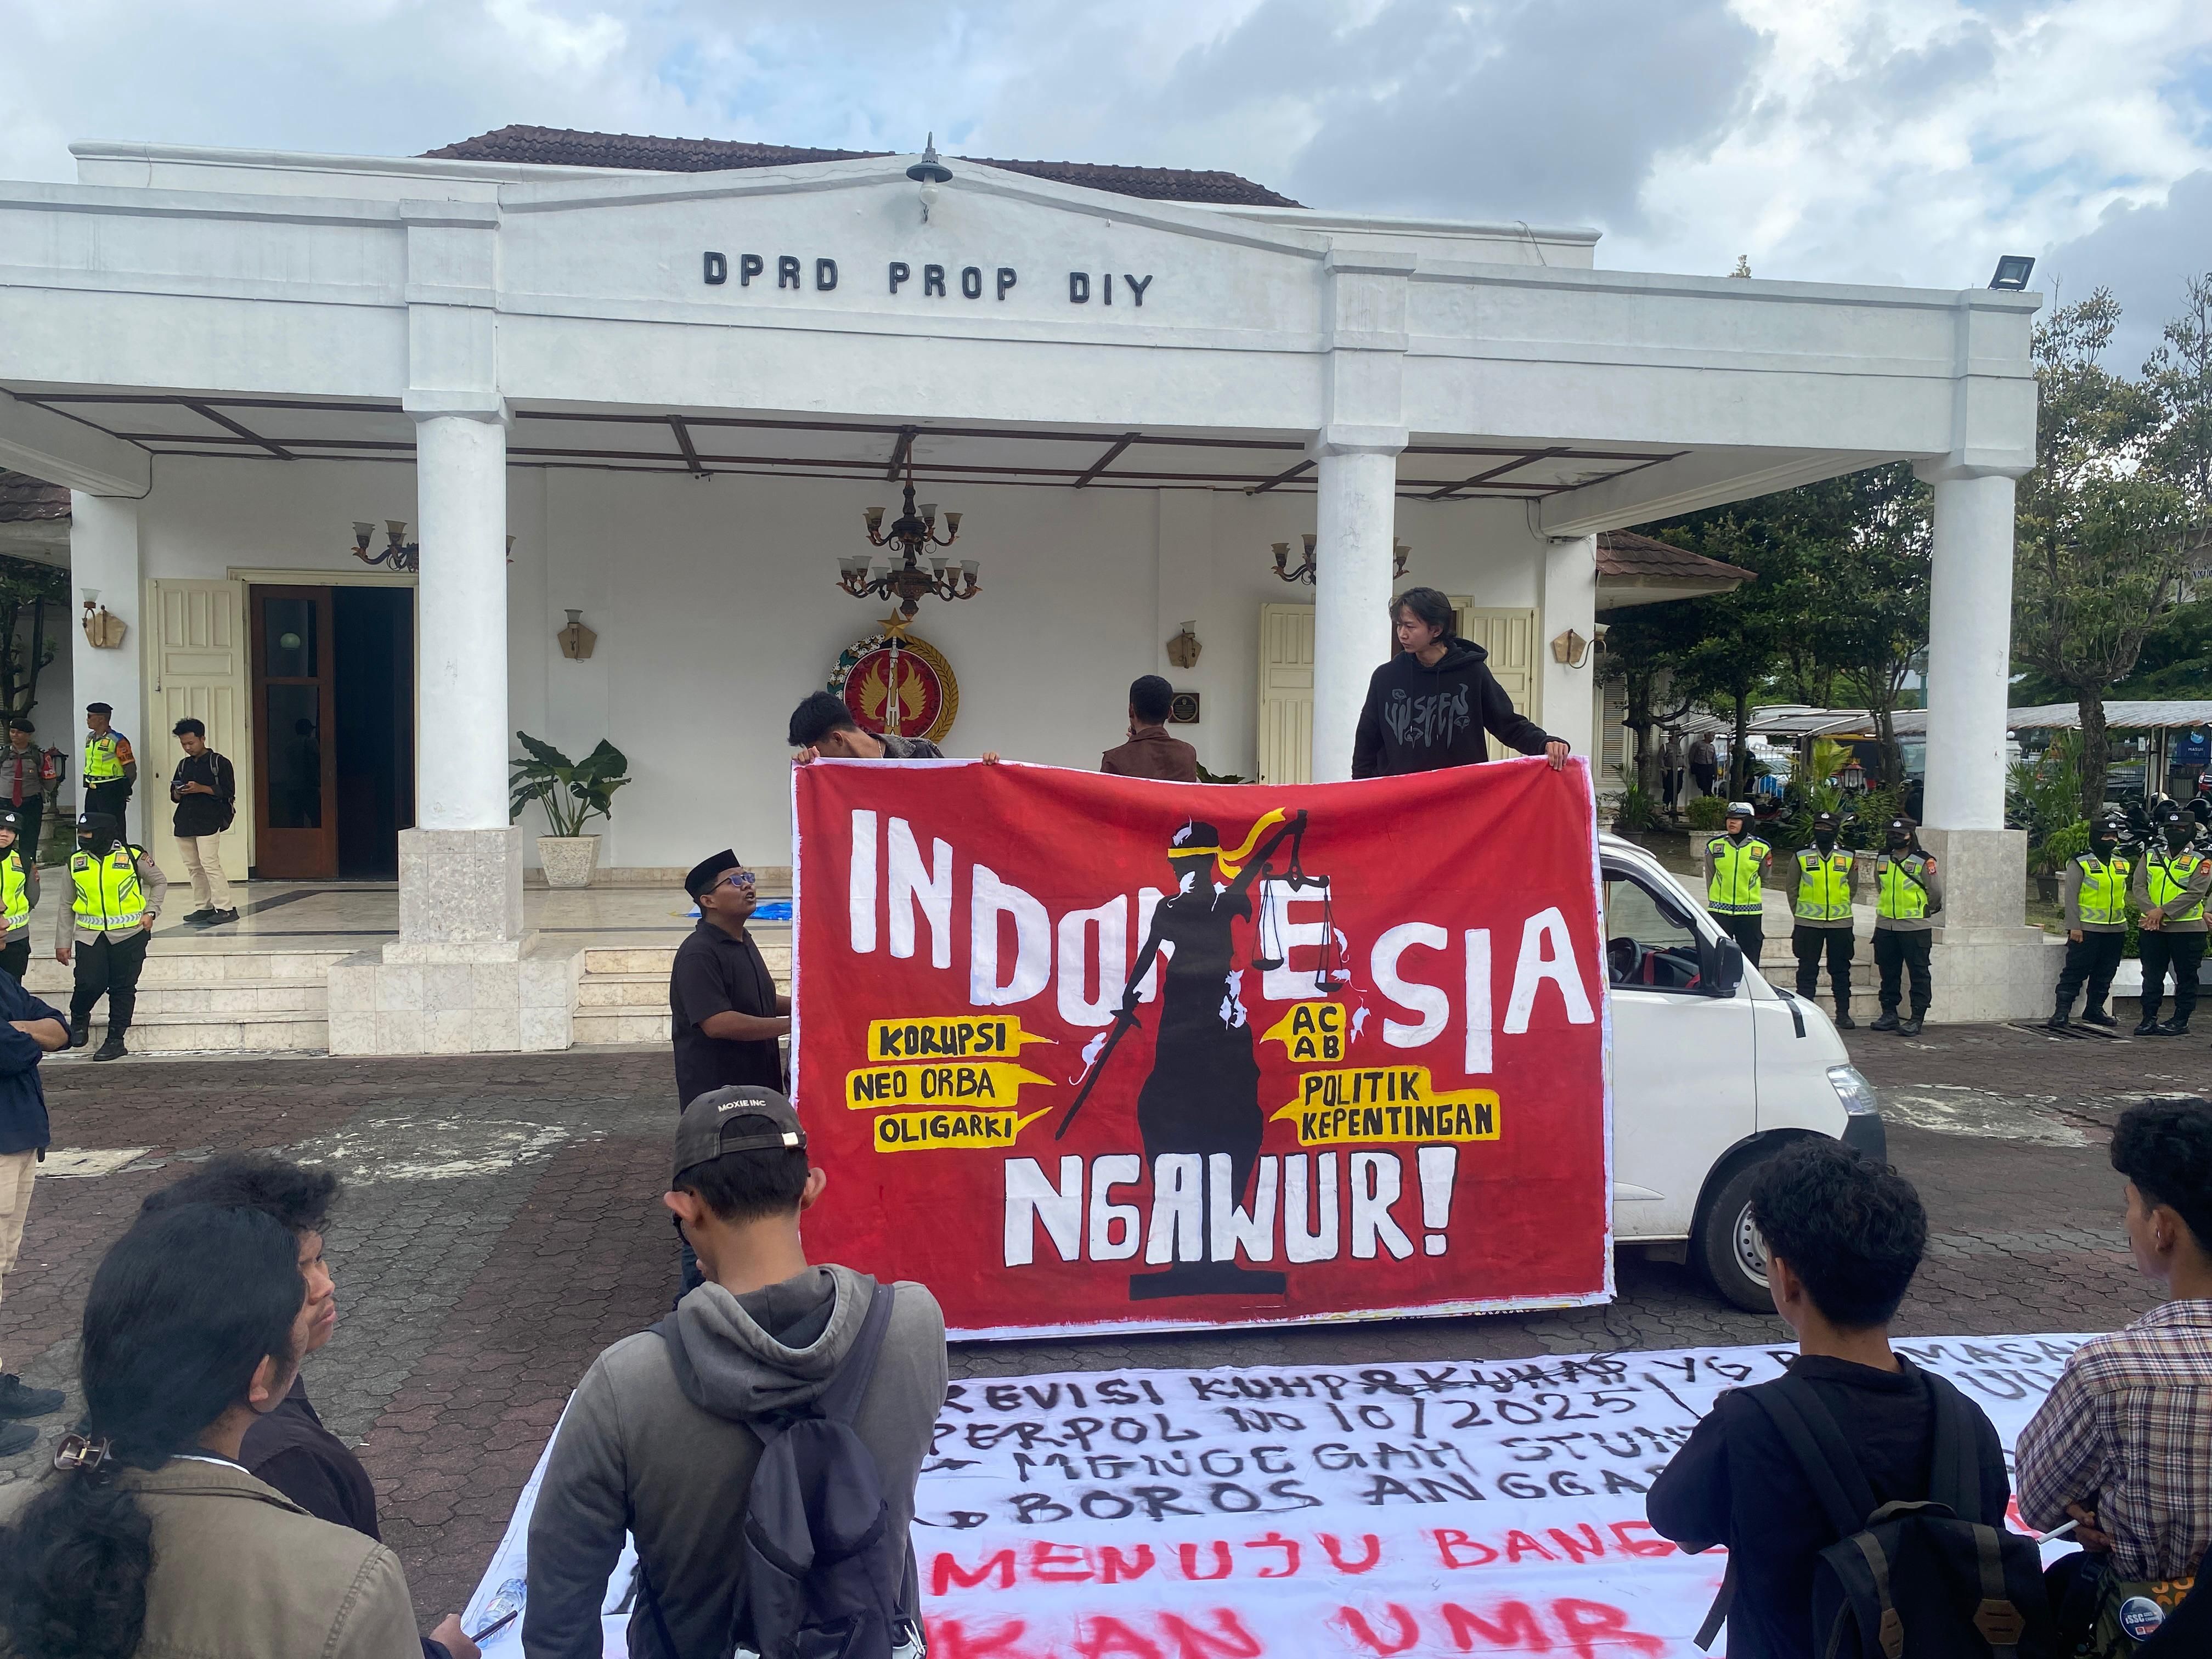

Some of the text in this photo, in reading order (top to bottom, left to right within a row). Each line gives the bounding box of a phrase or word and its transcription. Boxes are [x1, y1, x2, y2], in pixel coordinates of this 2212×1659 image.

[703, 251, 1154, 307] DPRD PROP DIY
[1292, 1005, 1338, 1036] AC
[879, 1022, 1006, 1057] KORUPSI
[1294, 1035, 1340, 1059] AB
[853, 1067, 995, 1102] NEO ORBA
[1305, 1071, 1420, 1107] POLITIK
[718, 1099, 767, 1113] MOXIE INC
[1302, 1103, 1494, 1141] KEPENTINGAN
[879, 1114, 1012, 1143] OLIGARKI
[1004, 1144, 1459, 1267] NGAWUR!
[938, 1378, 1164, 1414] REVISI
[929, 1413, 1203, 1455] PERPOL
[1220, 1406, 1307, 1432] NO
[1500, 1425, 1697, 1462] STUN
[1009, 1478, 1324, 1524] BOROS
[932, 1520, 1679, 1596] MENUJU BANG
[926, 1597, 1668, 1659] KAN UMR
